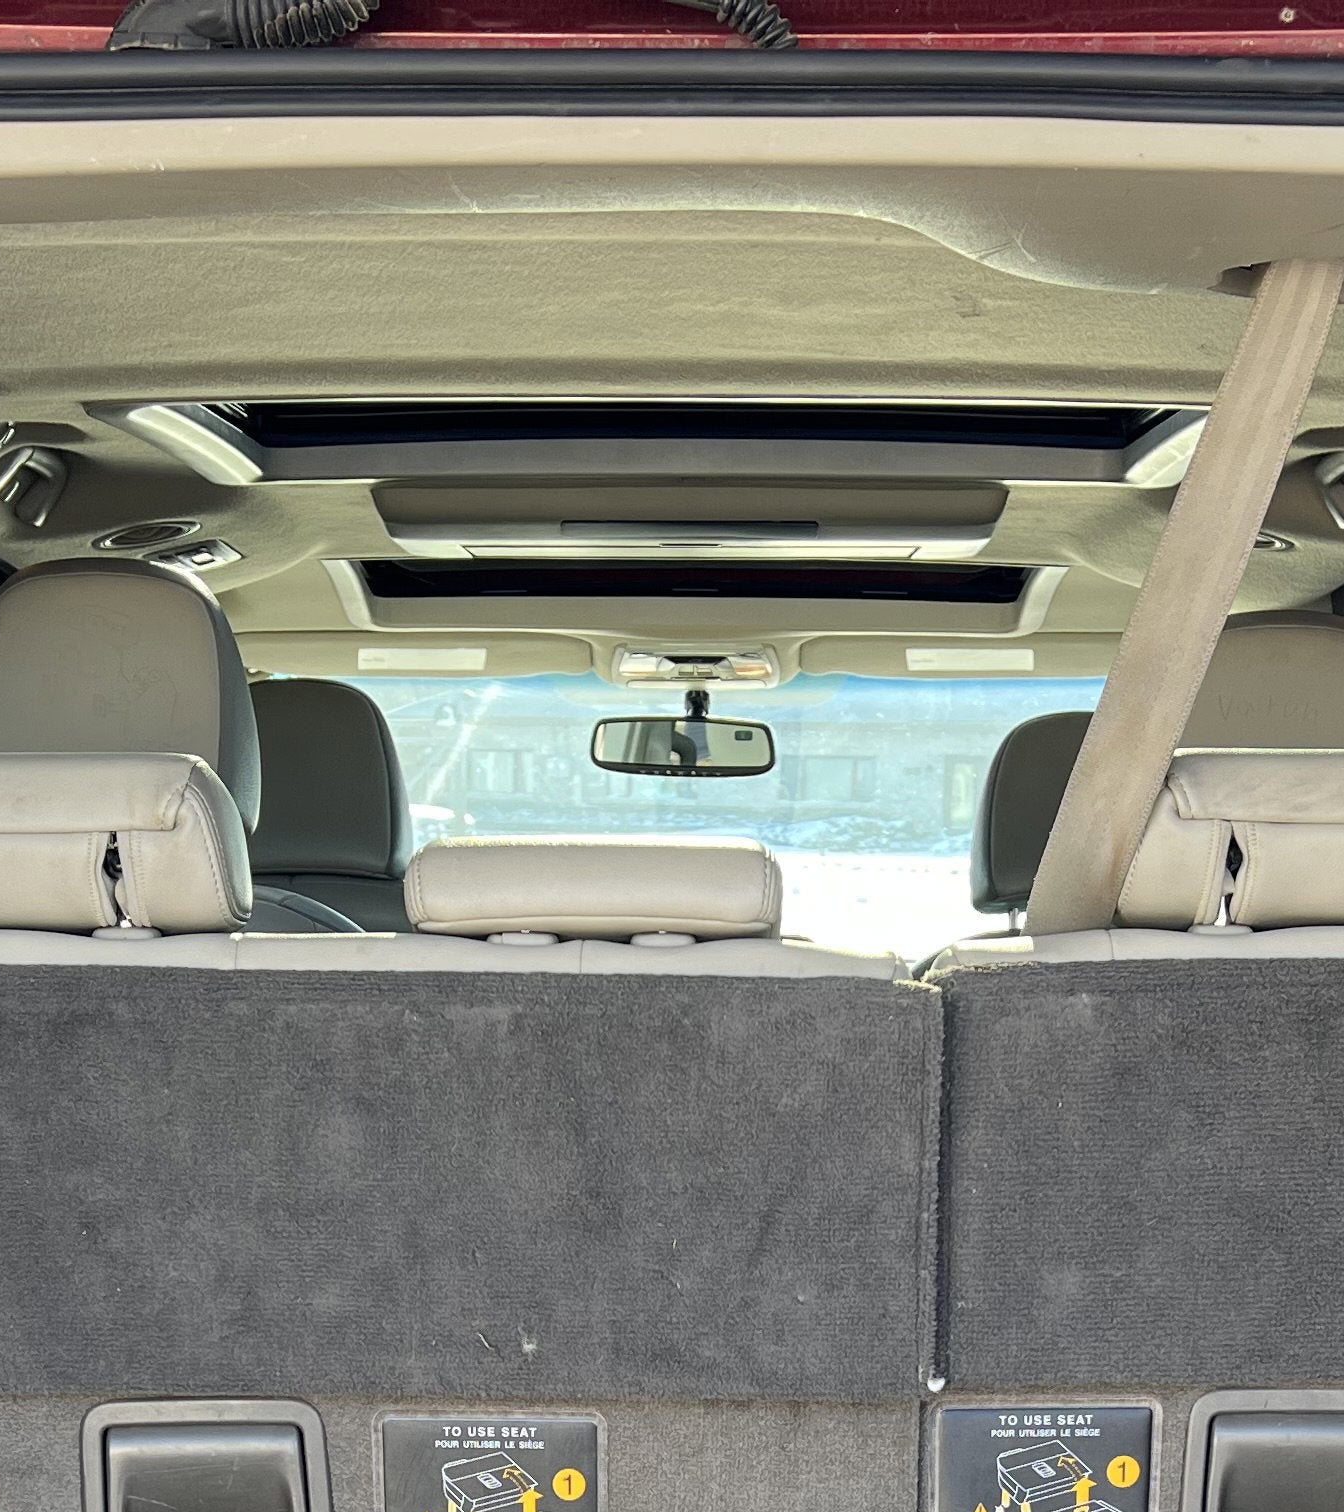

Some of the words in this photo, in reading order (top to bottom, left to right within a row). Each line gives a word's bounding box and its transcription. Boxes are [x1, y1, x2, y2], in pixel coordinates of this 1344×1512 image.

[999, 1416, 1018, 1426] TO
[1024, 1416, 1052, 1425] USE
[1057, 1415, 1093, 1425] SEAT
[443, 1427, 462, 1437] TO
[468, 1427, 496, 1437] USE
[502, 1427, 537, 1438] SEAT
[991, 1429, 1015, 1438] POUR
[1019, 1429, 1056, 1437] UTILISER
[1061, 1429, 1071, 1437] LE
[1075, 1427, 1101, 1437] SIÈGE
[435, 1440, 459, 1449] POUR
[463, 1440, 500, 1449] UTILISER
[505, 1441, 516, 1449] LE
[519, 1439, 545, 1450] SIÈGE
[1117, 1462, 1126, 1483] 1
[564, 1474, 572, 1496] 1
